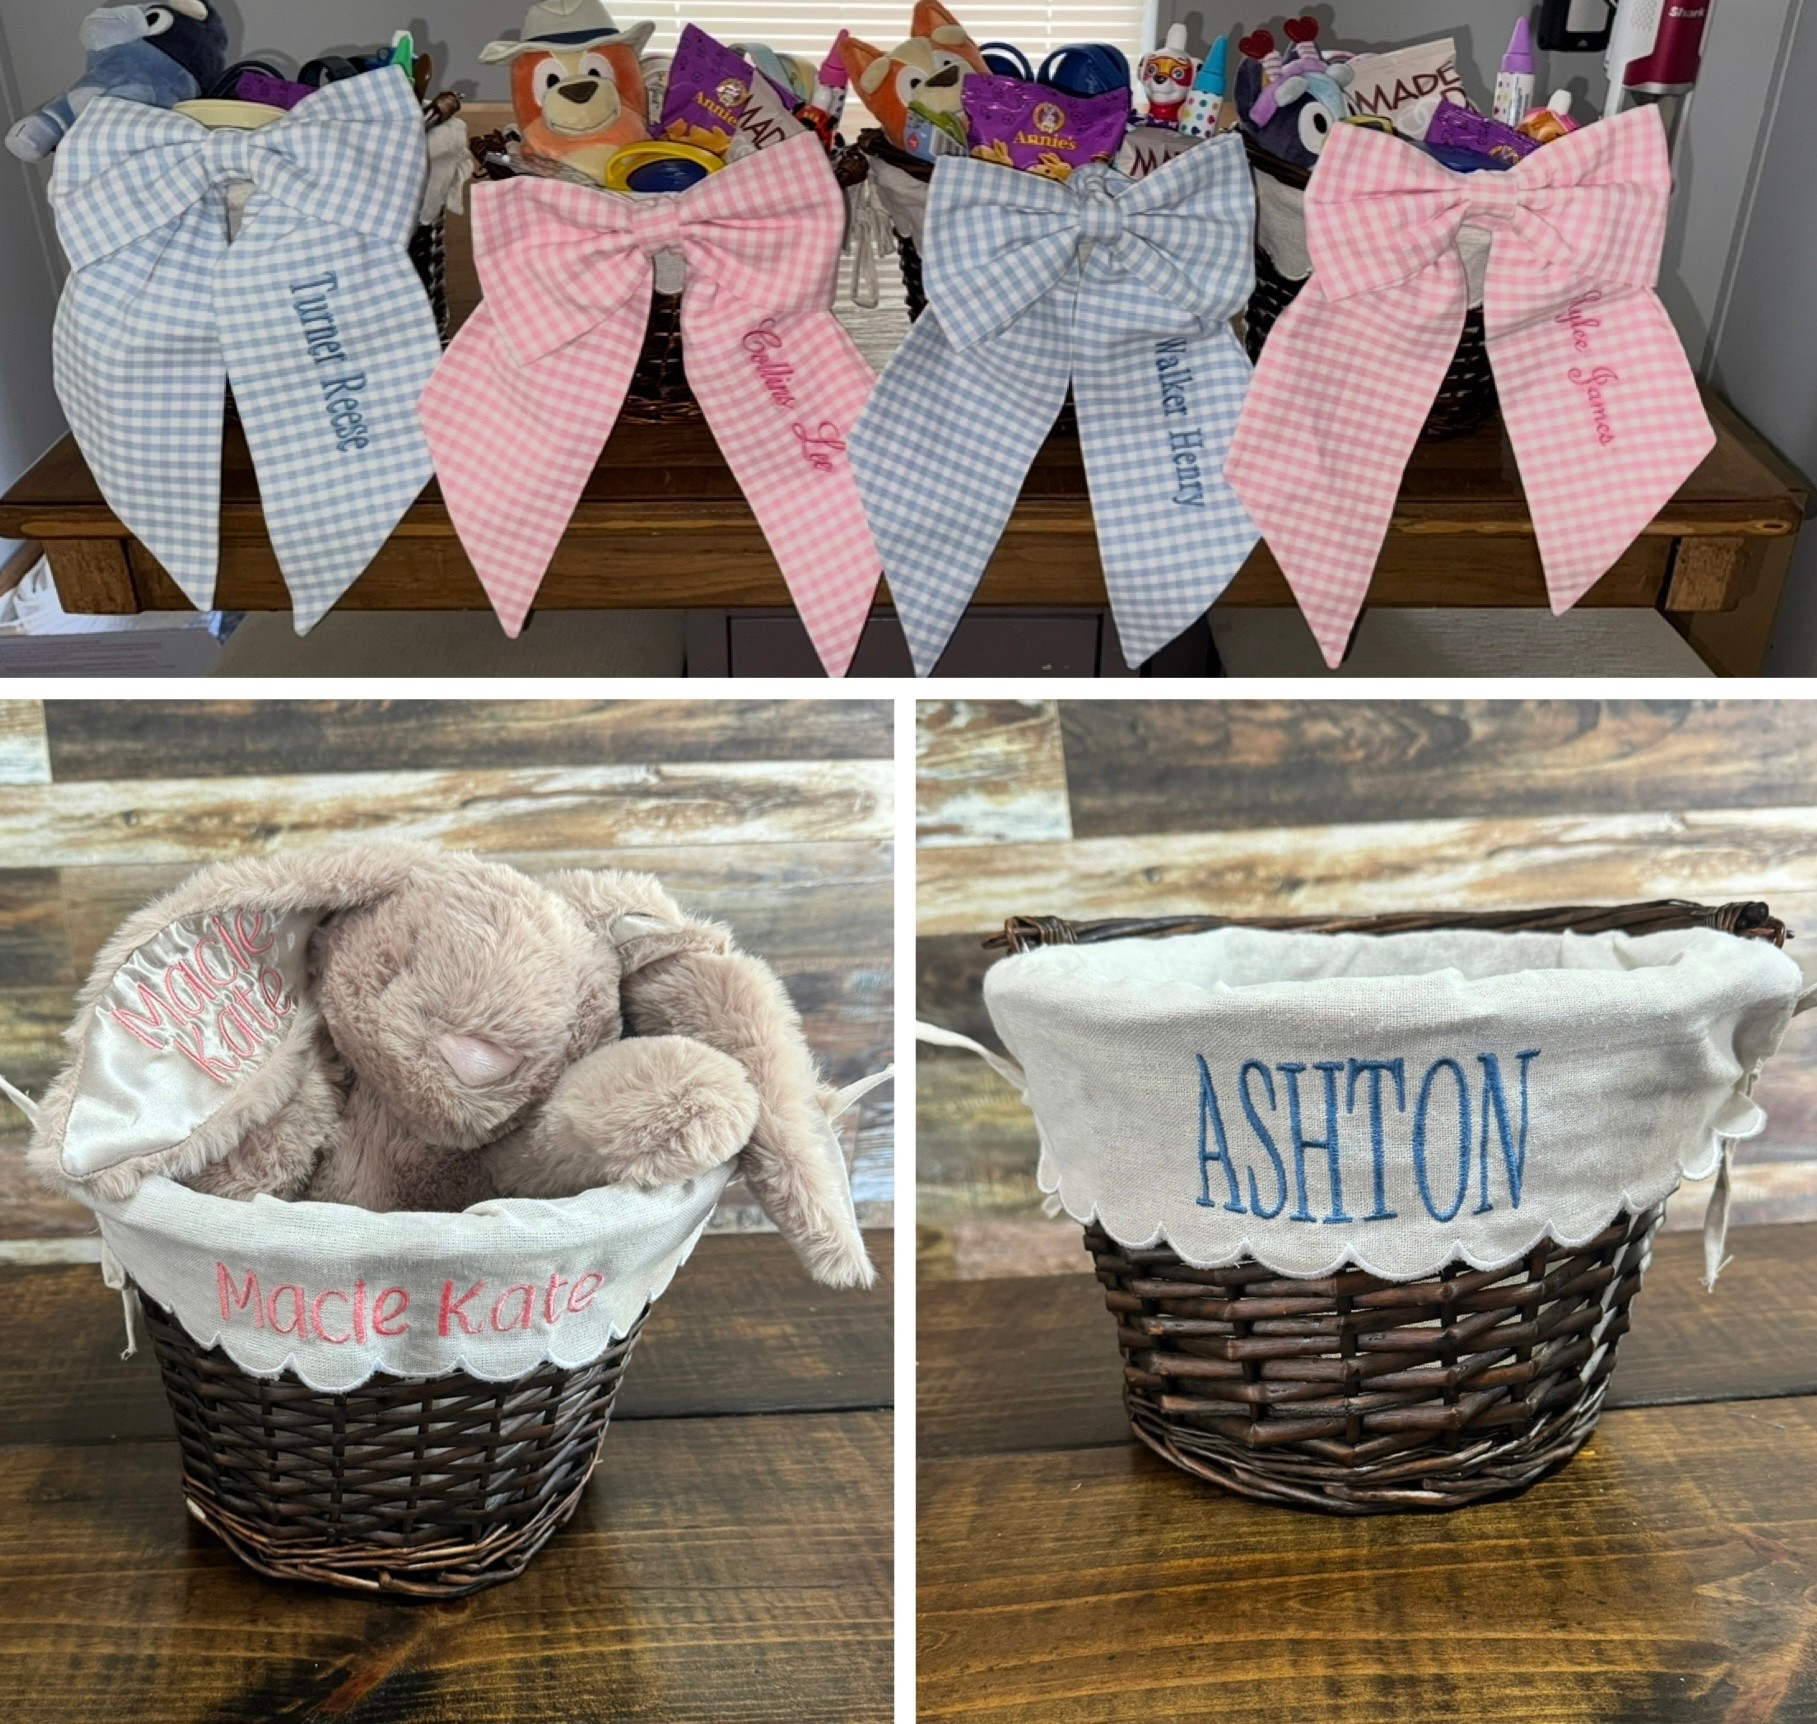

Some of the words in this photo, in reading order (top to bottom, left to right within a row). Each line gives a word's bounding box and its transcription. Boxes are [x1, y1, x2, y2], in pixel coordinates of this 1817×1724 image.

[1668, 6, 1705, 18] Shark
[693, 92, 738, 128] Annie
[738, 95, 786, 150] MAD
[1355, 60, 1462, 114] MADE
[1012, 130, 1077, 150] Annie's
[290, 271, 347, 364] Turner
[320, 371, 369, 452] Reese
[742, 318, 795, 408] Collins
[792, 421, 846, 473] Lee
[1155, 337, 1194, 417] Walker
[1568, 367, 1618, 446] James
[1168, 427, 1206, 507] Henry
[175, 965, 292, 1084] Kate
[1195, 1050, 1542, 1224] ASHTON
[438, 1270, 605, 1338] Kate
